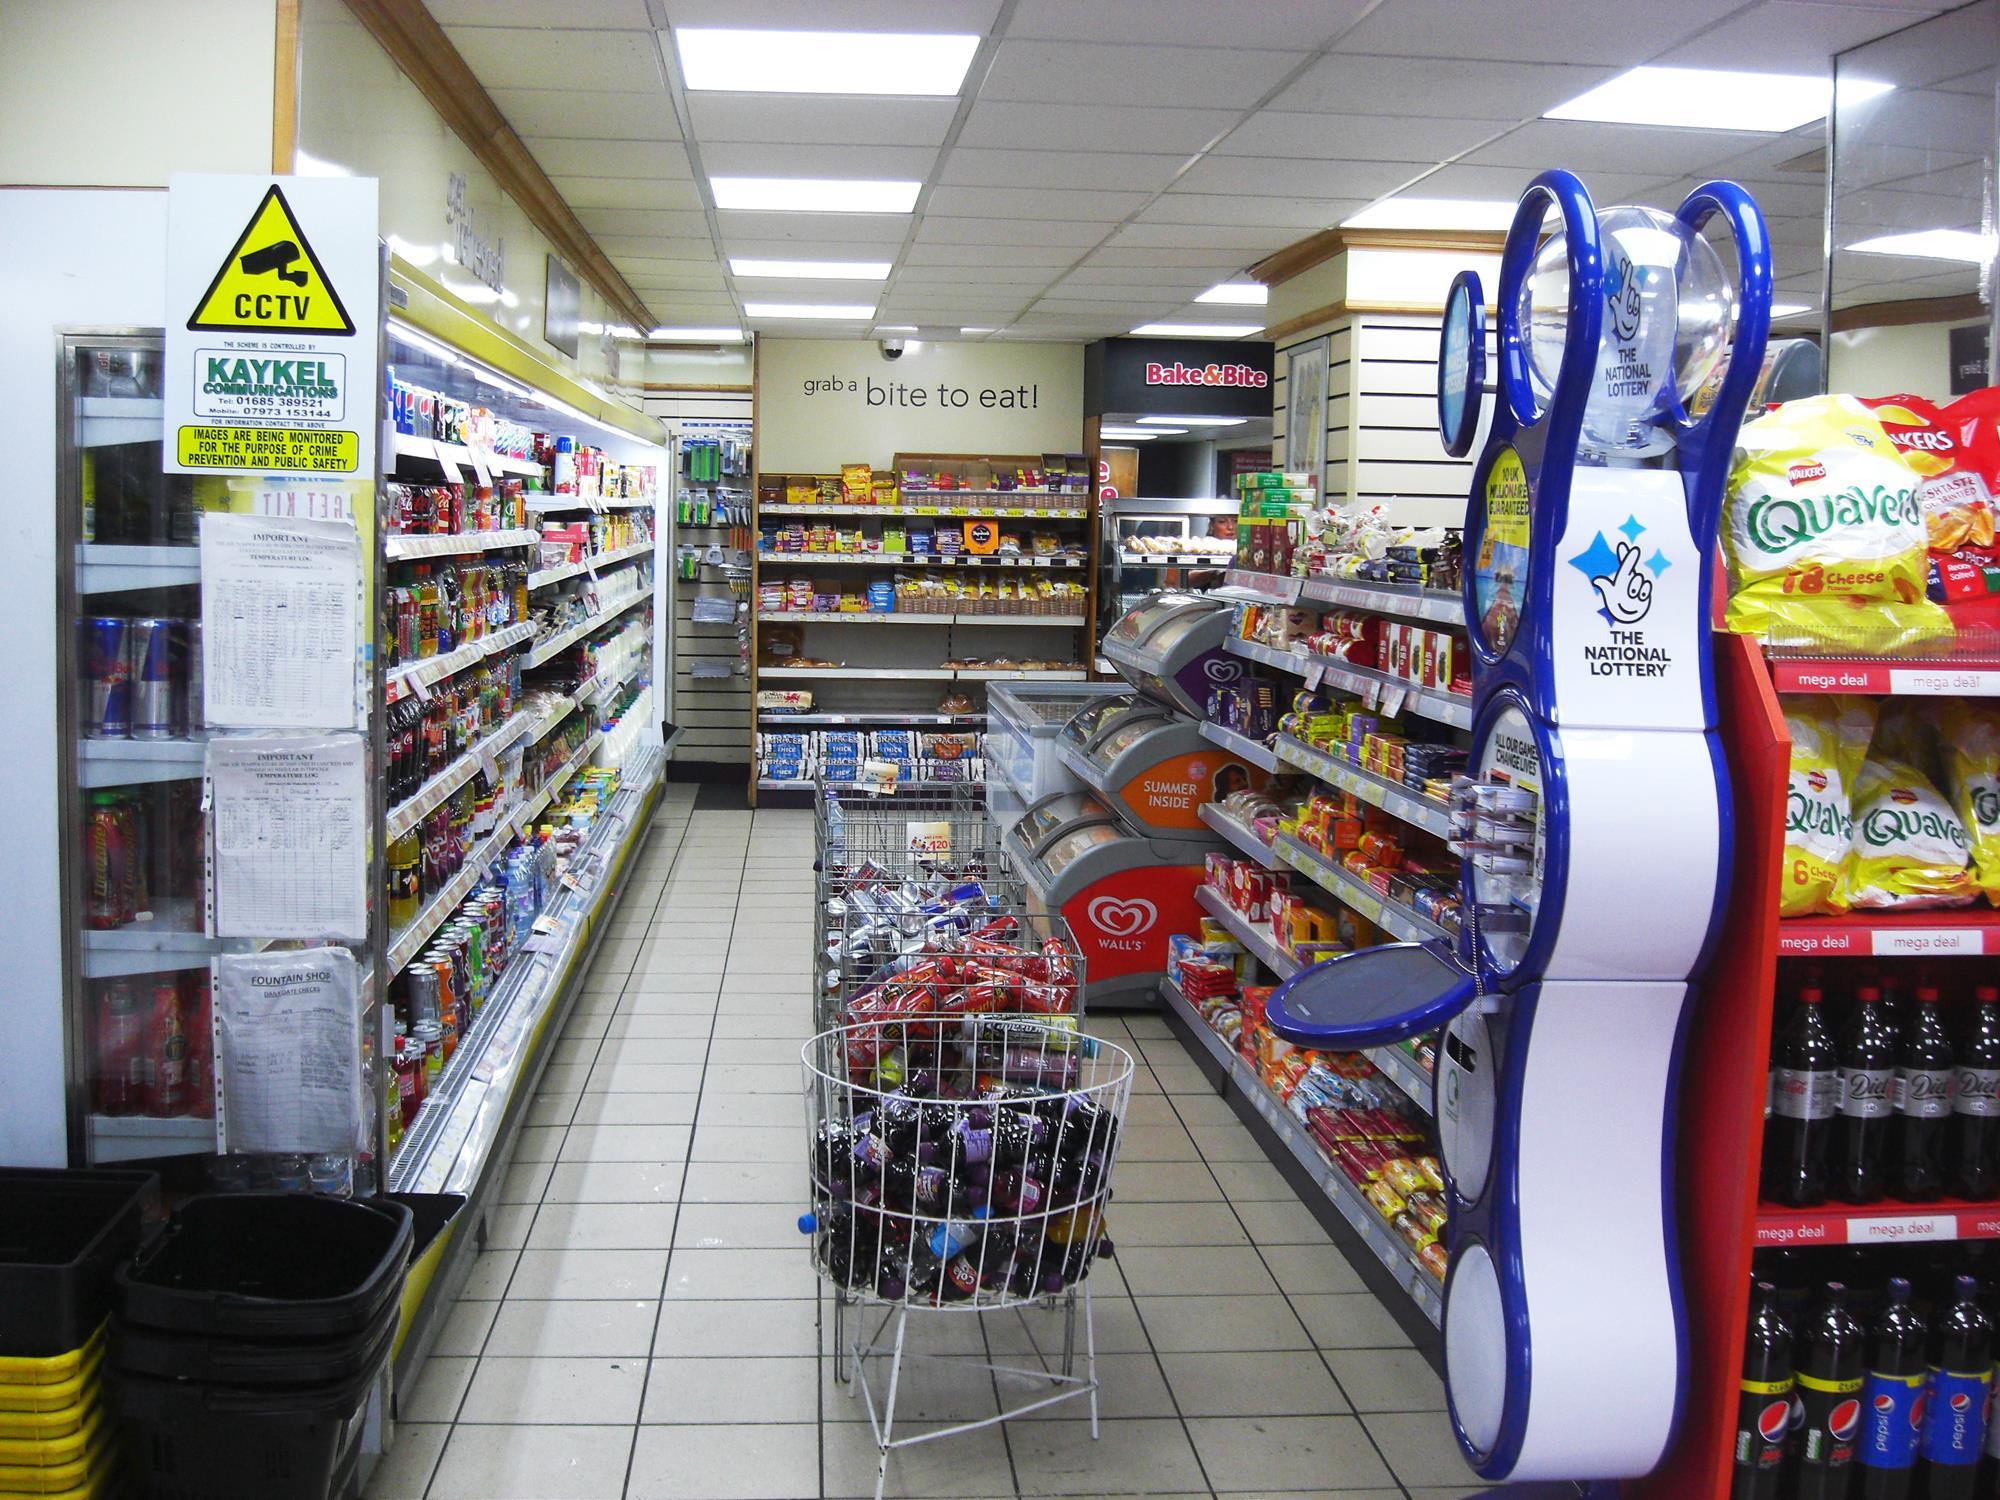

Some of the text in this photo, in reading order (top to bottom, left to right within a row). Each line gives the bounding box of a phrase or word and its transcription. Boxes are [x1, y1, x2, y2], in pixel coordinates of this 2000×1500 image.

[234, 293, 310, 321] CCTV
[270, 342, 306, 350] CONTROLLED
[1618, 349, 1636, 363] THE
[208, 357, 335, 386] KAYKEL
[1146, 362, 1268, 388] Bake&Bite
[1605, 365, 1652, 381] NATIONAL
[203, 382, 338, 400] COMMUNICATIONS
[804, 375, 1038, 410] grab a bite to eat!
[1608, 381, 1650, 397] LOTTERY
[236, 396, 274, 406] 01685
[279, 398, 323, 408] 389521
[243, 407, 281, 416] 07973
[287, 409, 331, 418] 153144
[225, 419, 262, 427] INFORMATION
[265, 420, 291, 428] CONTACT
[194, 429, 344, 444] IMAGES ARE BEING MONITORED
[1889, 431, 1954, 450] LKERS
[199, 441, 338, 457] FOR THE PURPOSE OF CRIME
[188, 453, 348, 470] PREVENTION AND PUBLIC SAFETY
[1502, 467, 1519, 481] 10 UK
[1788, 466, 1826, 480] WALKERS
[1489, 500, 1530, 515] GUARANTEED
[253, 534, 309, 542] IMPORTANT
[1827, 572, 1885, 585] Cheese
[1609, 630, 1644, 645] THE
[1585, 646, 1672, 662] NATIONAL
[1590, 662, 1666, 677] LOTTERY
[1799, 673, 1868, 688] mega deal
[1913, 675, 1981, 690] mega deal
[825, 734, 858, 744] BRACES
[1495, 733, 1539, 760] ALL OUR GAMES
[257, 753, 314, 761] IMPORTANT
[823, 757, 857, 767] BRACES
[1496, 751, 1537, 776] CHANGE LIVES
[1144, 780, 1197, 796] SUMMER
[1149, 796, 1190, 809] INSIDE
[1863, 808, 1966, 849] Quave
[1793, 860, 1809, 885] 6
[1098, 938, 1142, 950] WALL'S
[1781, 935, 1849, 950] mega deal
[1894, 934, 1960, 950] mega deal
[251, 972, 331, 985] FOUNTAIN SHOP
[1758, 1225, 1825, 1241] mega deal
[1869, 1220, 1935, 1237] mega deal
[1876, 1414, 1888, 1452] pepsi
[1952, 1414, 1965, 1449] pepsi
